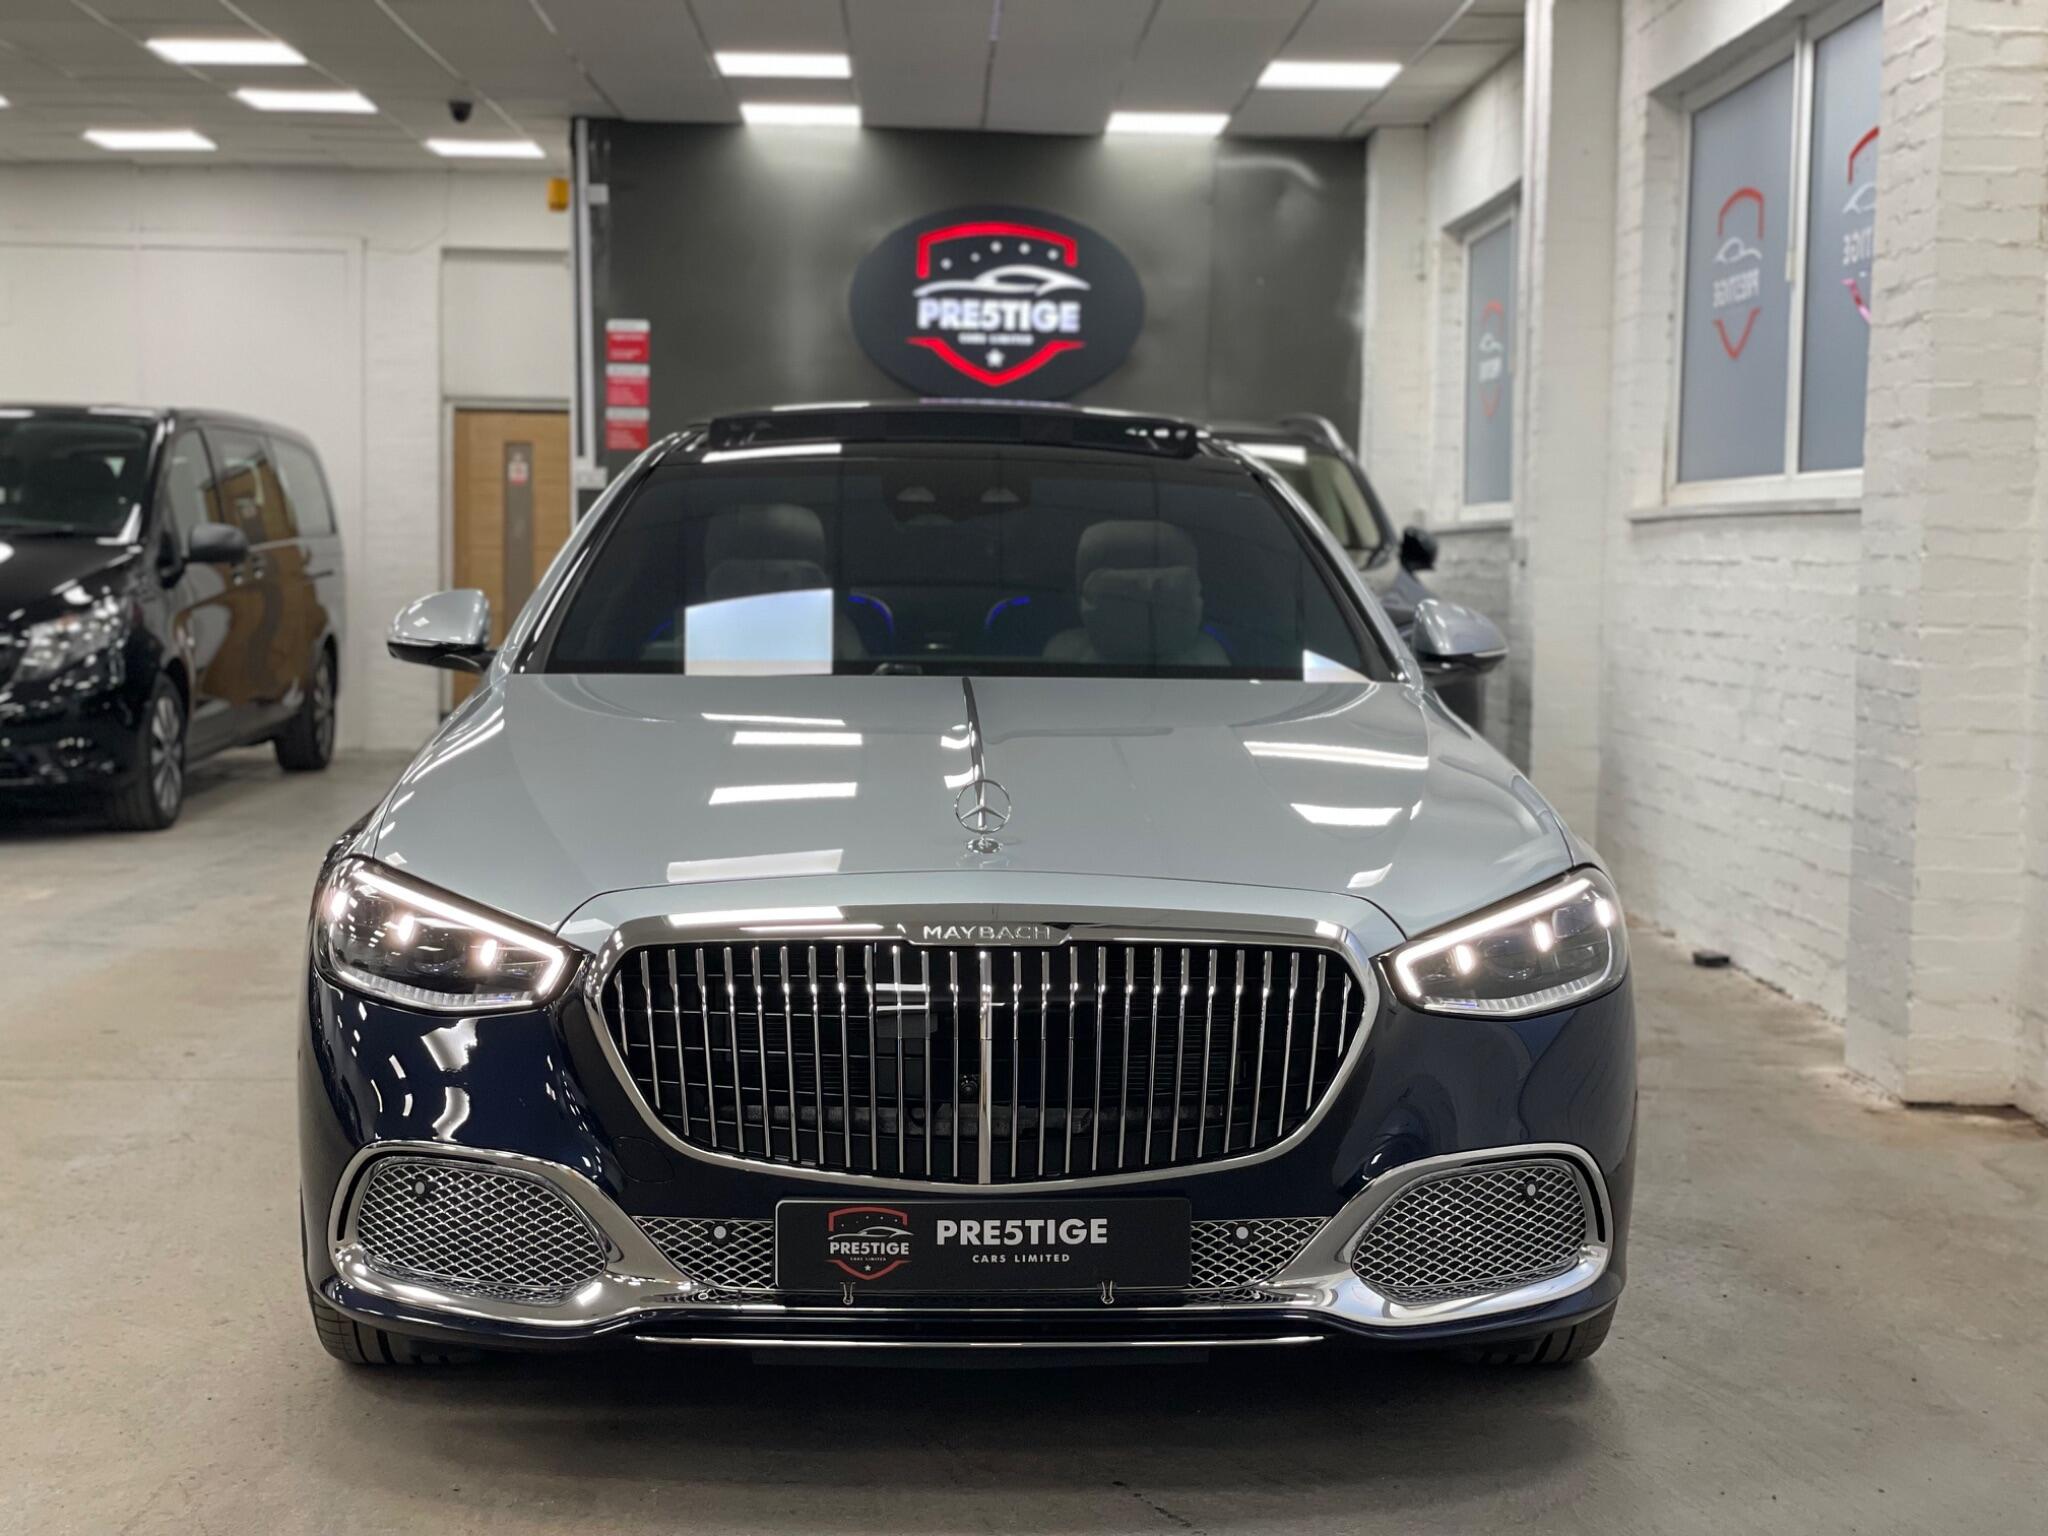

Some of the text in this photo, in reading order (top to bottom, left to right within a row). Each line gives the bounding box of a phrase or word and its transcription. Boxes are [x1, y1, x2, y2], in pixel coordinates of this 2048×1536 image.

[916, 299, 1080, 332] PRE5TIGE
[923, 925, 1050, 940] MAYBACH
[936, 1218, 1108, 1246] PRE5TIGE
[829, 1241, 910, 1255] PRE5TIGE
[972, 1253, 1070, 1264] CARS LIMITED
